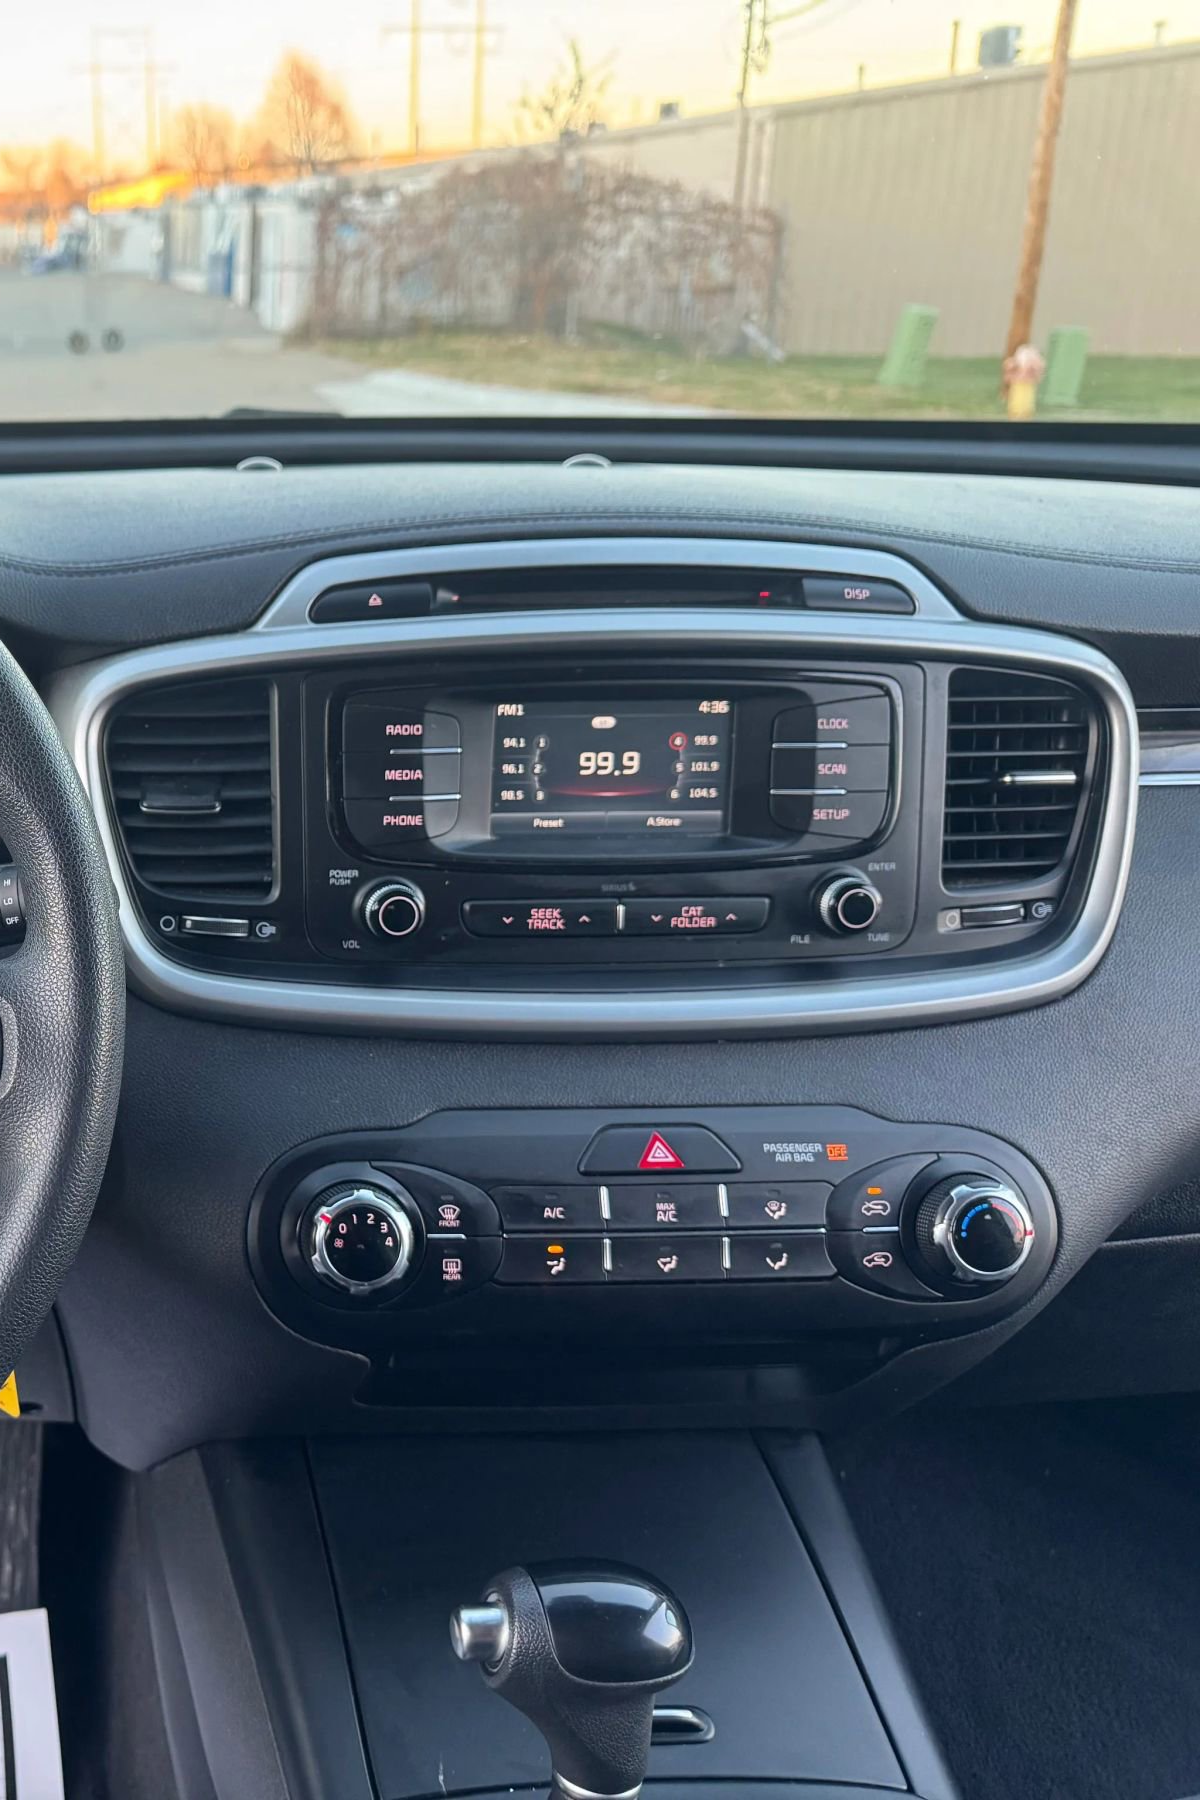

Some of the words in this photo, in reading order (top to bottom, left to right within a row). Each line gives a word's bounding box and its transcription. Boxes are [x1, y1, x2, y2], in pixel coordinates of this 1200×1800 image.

[843, 587, 870, 600] DISP
[497, 704, 525, 716] FM1
[698, 700, 730, 714] 4:36
[817, 718, 848, 729] CLOCK
[386, 724, 423, 736] RADIO
[579, 751, 641, 776] 99.9
[818, 763, 847, 775] SCAN
[385, 769, 423, 781] MEDIA
[813, 808, 850, 820] SETUP
[383, 815, 423, 826] PHONE
[533, 817, 565, 828] Preset
[868, 862, 896, 872] ENTER
[329, 869, 359, 879] POWER
[3, 879, 11, 887] HI
[329, 878, 351, 886] PUSH
[3, 898, 13, 906] LO
[530, 908, 561, 919] SEEK
[681, 906, 704, 917] CAT
[5, 916, 20, 926] OFF
[527, 919, 566, 930] TRACK
[671, 916, 717, 928] FOLDER
[791, 934, 810, 944] FILE
[867, 933, 890, 942] TUNE
[342, 940, 360, 949] VOL
[763, 1143, 822, 1153] PASSENGER
[827, 1145, 847, 1158] OFF
[775, 1153, 792, 1162] AIR
[793, 1153, 814, 1162] BAG
[352, 1213, 358, 1224] 1
[367, 1213, 375, 1224] 2
[543, 1207, 565, 1219] A/C
[656, 1210, 678, 1222] A/C
[339, 1223, 347, 1234] 0
[380, 1222, 389, 1233] 3
[385, 1236, 394, 1247] 4
[443, 1274, 461, 1282] REAR
